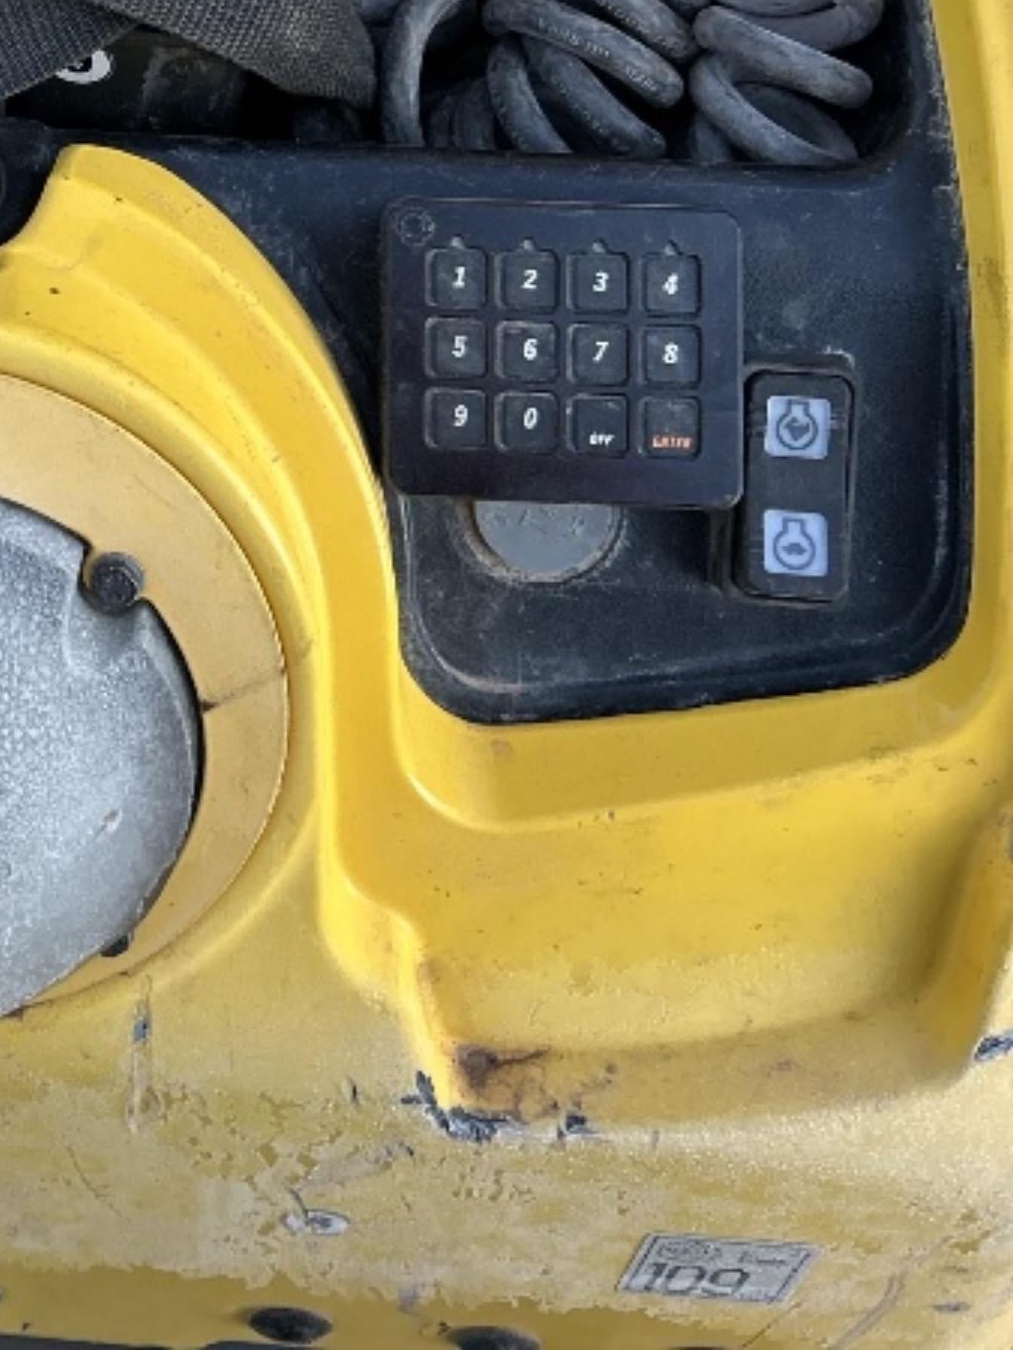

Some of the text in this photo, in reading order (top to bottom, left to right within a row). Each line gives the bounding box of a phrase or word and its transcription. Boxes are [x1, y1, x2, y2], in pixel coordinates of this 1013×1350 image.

[452, 266, 679, 295] 1 2 3 4
[452, 335, 679, 364] 5 6 7 8
[453, 404, 468, 427] 9
[523, 407, 538, 430] 0
[644, 1262, 750, 1297] 109
